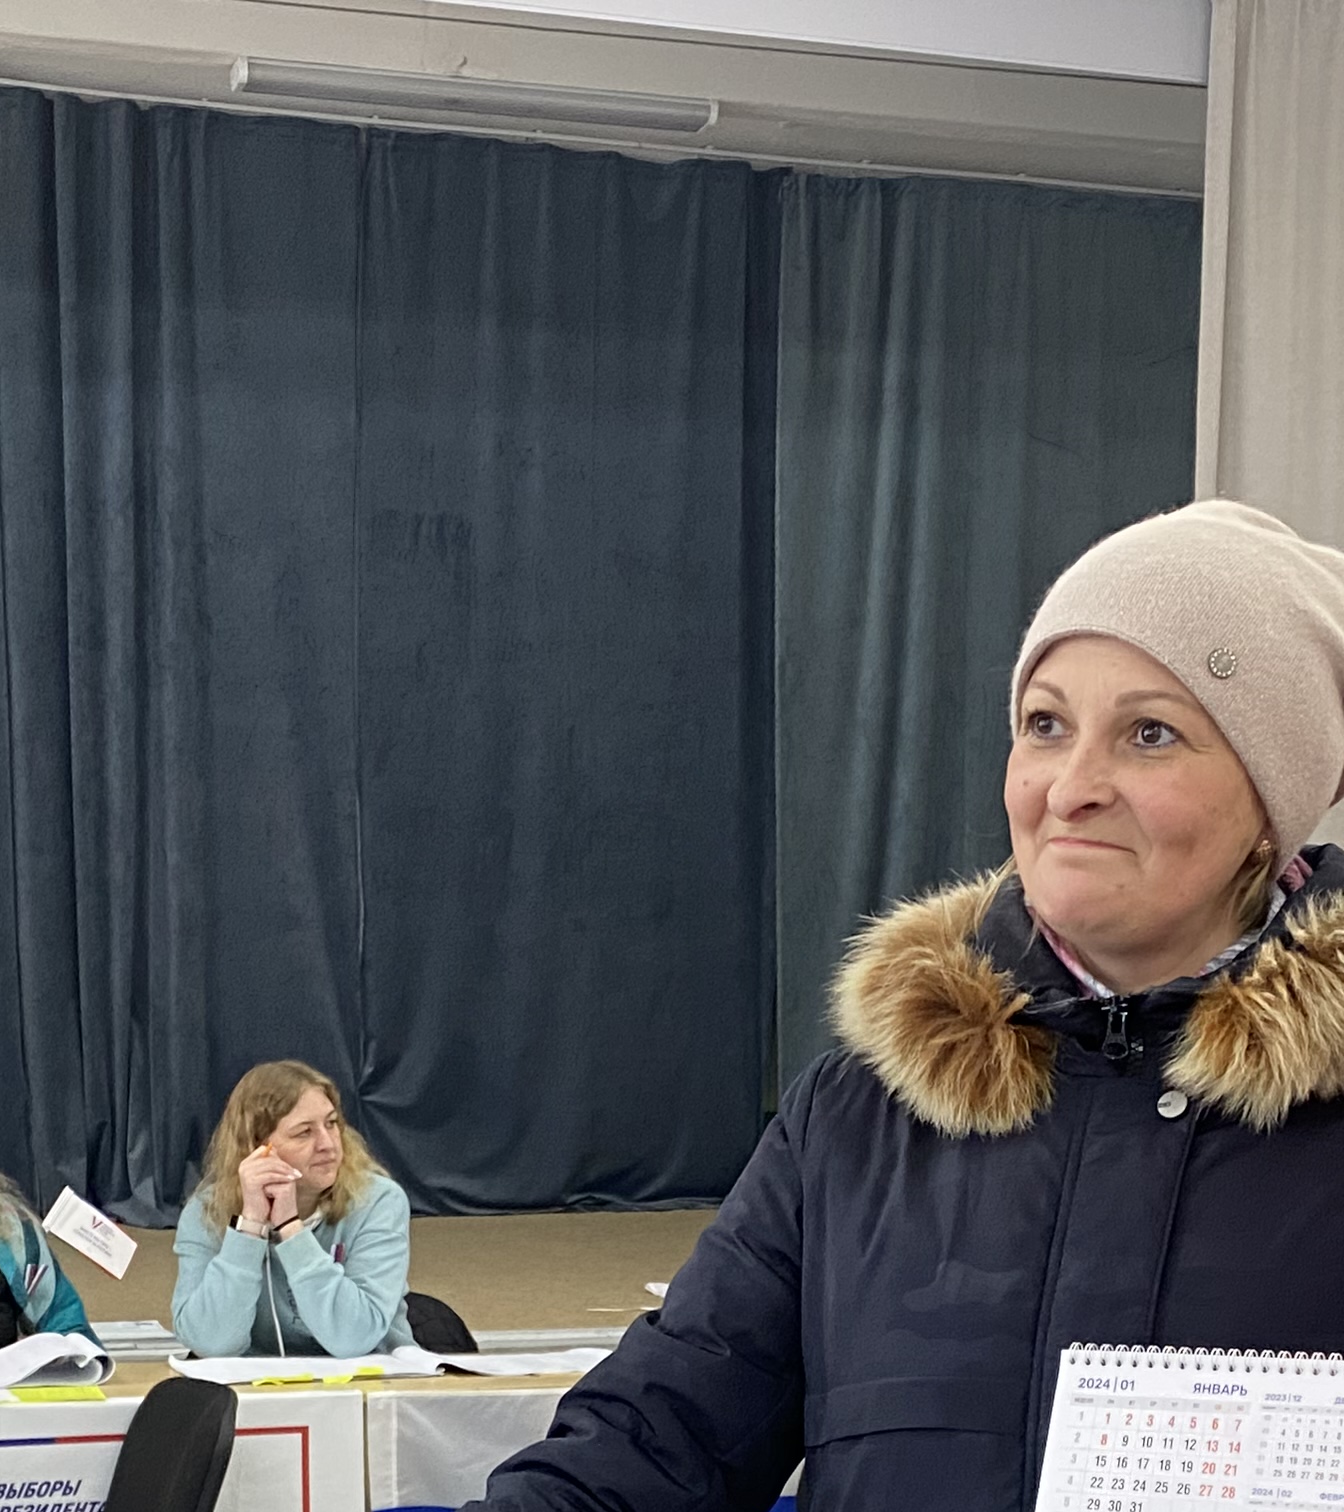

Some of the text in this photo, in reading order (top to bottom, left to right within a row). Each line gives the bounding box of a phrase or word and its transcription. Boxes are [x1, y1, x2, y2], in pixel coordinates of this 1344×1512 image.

[1078, 1378, 1110, 1389] 2024
[1121, 1380, 1134, 1391] 01
[1193, 1383, 1247, 1396] ЯНВАРЬ
[1106, 1413, 1110, 1424] 1
[1125, 1414, 1133, 1425] 2
[1147, 1415, 1154, 1427] 3
[1168, 1416, 1175, 1427] 4
[1190, 1417, 1197, 1429] 5
[1212, 1418, 1218, 1430] 6
[1235, 1419, 1242, 1432] 7
[1101, 1434, 1107, 1445] 8
[1122, 1435, 1128, 1446] 9
[1142, 1437, 1153, 1447] 10
[1164, 1438, 1173, 1449] 11
[1185, 1439, 1196, 1450] 12
[1207, 1440, 1218, 1452] 13
[1229, 1442, 1240, 1453] 14
[1096, 1456, 1106, 1467] 15
[1117, 1457, 1128, 1468] 16
[1138, 1458, 1149, 1469] 17
[1160, 1460, 1171, 1471] 18
[1182, 1461, 1193, 1472] 19
[1202, 1462, 1216, 1474] 20
[1224, 1464, 1237, 1476] 21
[1090, 1477, 1103, 1488] 22
[1111, 1478, 1125, 1490] 23
[1133, 1480, 1146, 1491] 24
[1155, 1481, 1168, 1493] 25
[1177, 1483, 1190, 1495] 26
[1199, 1484, 1213, 1496] 27
[1222, 1486, 1235, 1499] 28
[1087, 1499, 1142, 1512] 29 30 31
